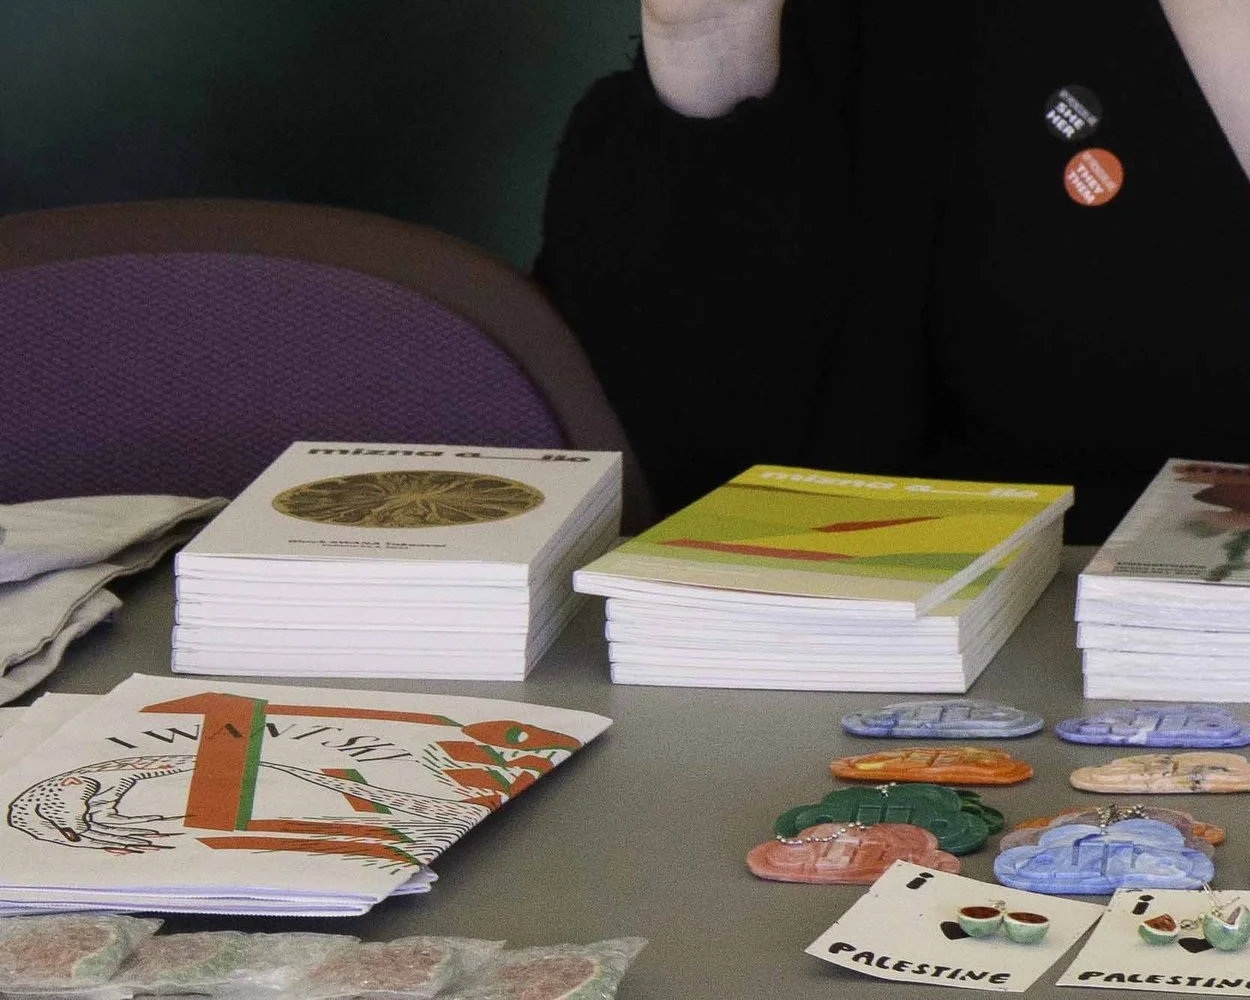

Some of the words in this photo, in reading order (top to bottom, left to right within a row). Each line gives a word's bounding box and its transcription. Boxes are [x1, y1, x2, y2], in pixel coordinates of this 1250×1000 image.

[308, 447, 444, 458] mizna
[105, 736, 138, 749] I
[142, 722, 342, 744] WANT
[321, 735, 421, 763] SKY
[828, 941, 1011, 986] PALESTINE
